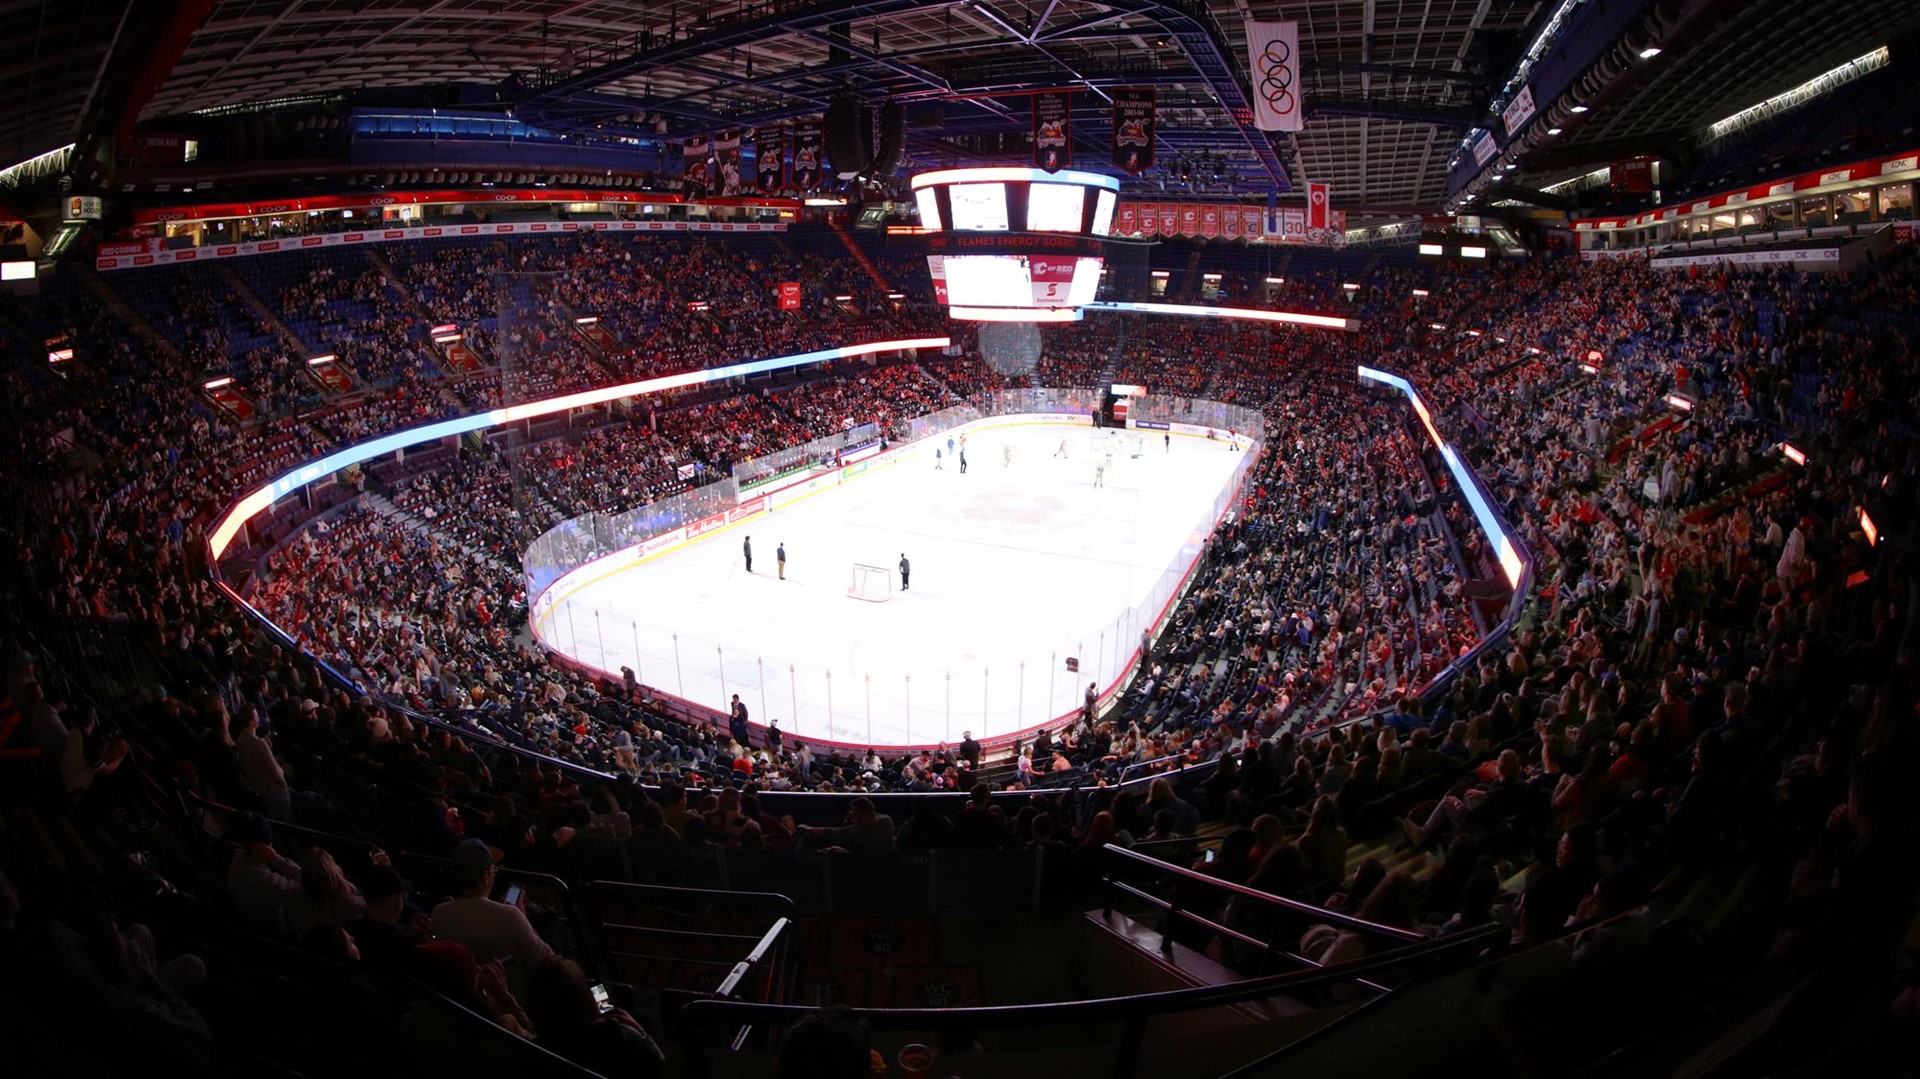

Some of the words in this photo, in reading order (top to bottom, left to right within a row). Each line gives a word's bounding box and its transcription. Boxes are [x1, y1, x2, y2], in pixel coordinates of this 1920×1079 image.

[1116, 100, 1152, 108] CHAMPIONS
[1285, 222, 1303, 233] 30
[958, 236, 995, 246] FLAMES
[997, 237, 1040, 246] ENERGY
[1043, 237, 1076, 247] BOARD
[687, 525, 700, 538] Tim
[700, 519, 724, 534] Hortons
[647, 535, 679, 550] Scotiabank
[924, 983, 953, 993] WC
